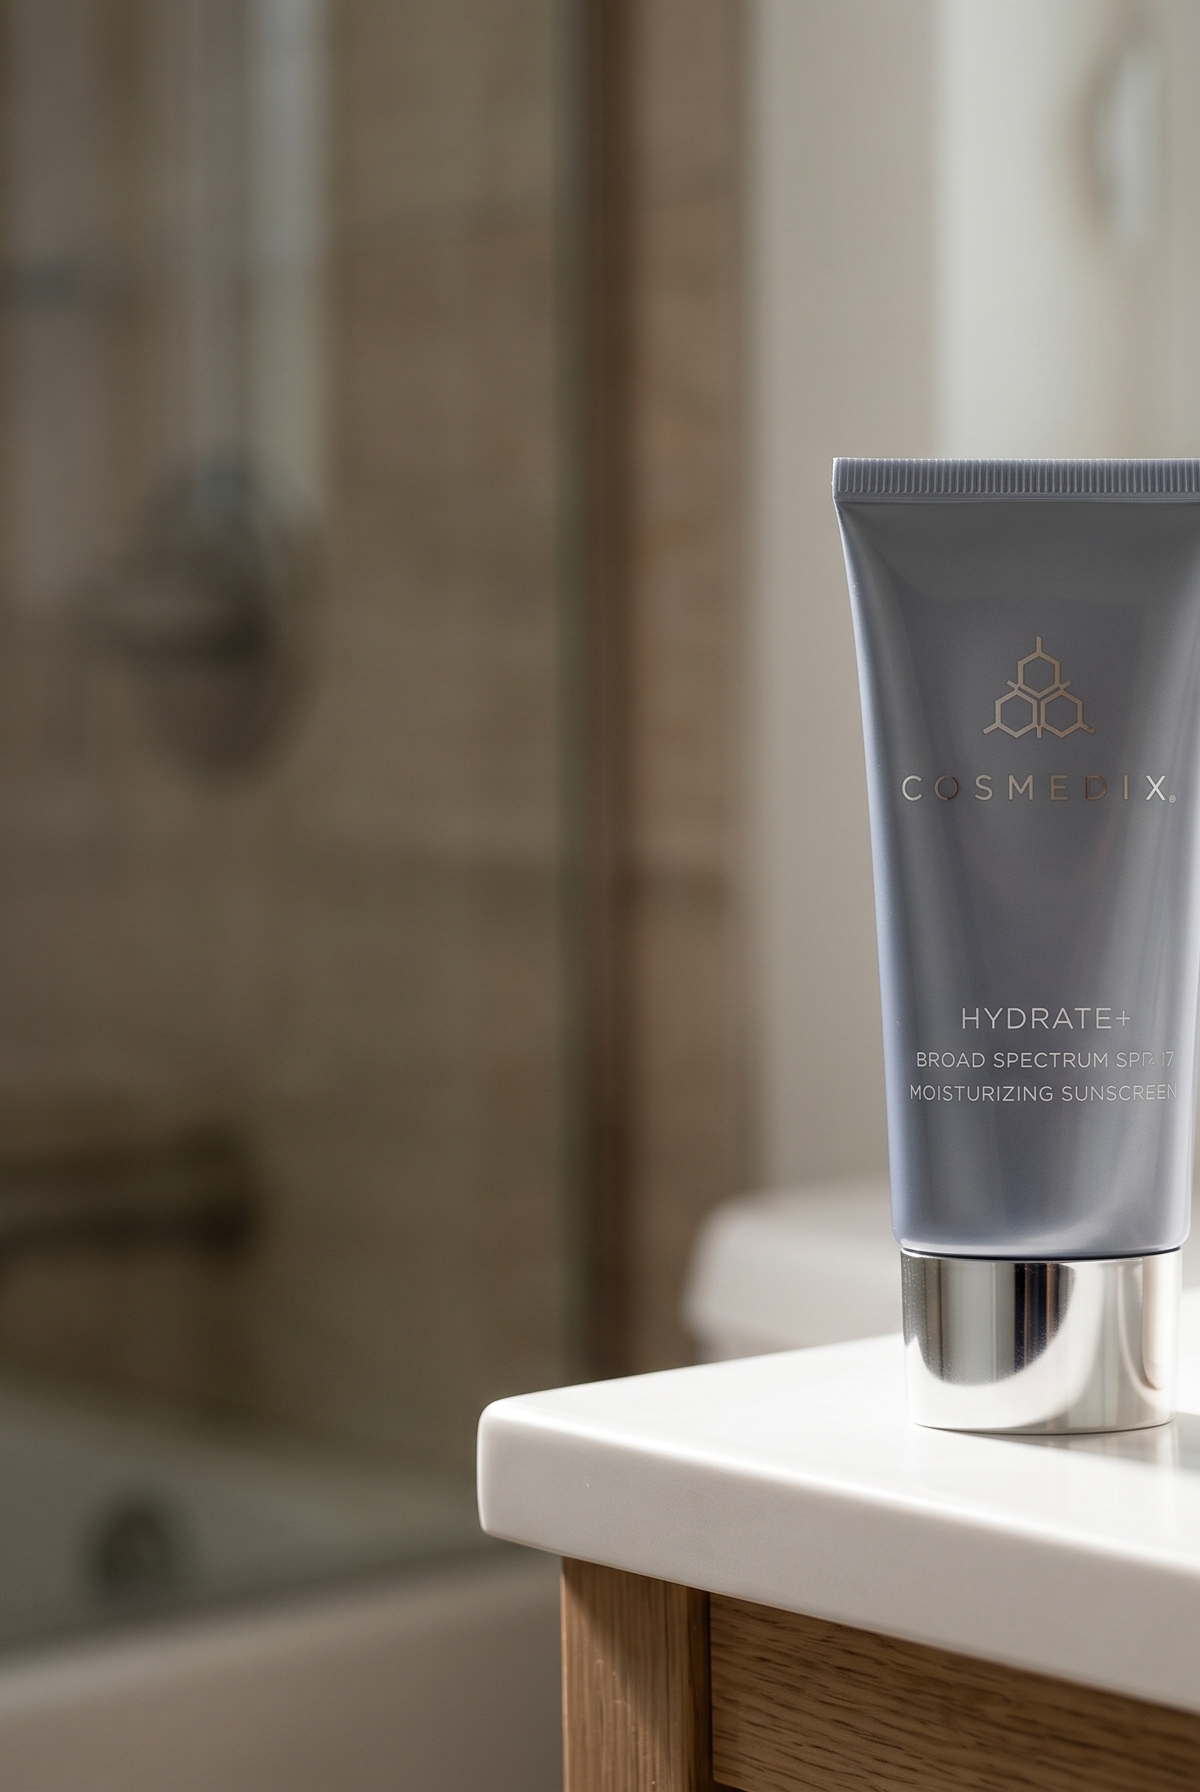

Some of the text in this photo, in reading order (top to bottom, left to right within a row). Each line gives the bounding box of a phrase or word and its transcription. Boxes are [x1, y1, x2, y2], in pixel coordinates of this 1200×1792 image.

[961, 1007, 1131, 1029] HYDRATE+
[916, 1051, 986, 1068] BROAD
[993, 1052, 1108, 1068] SPECTRUM
[909, 1083, 1178, 1102] MOISTURIZING SUNSCREEN
